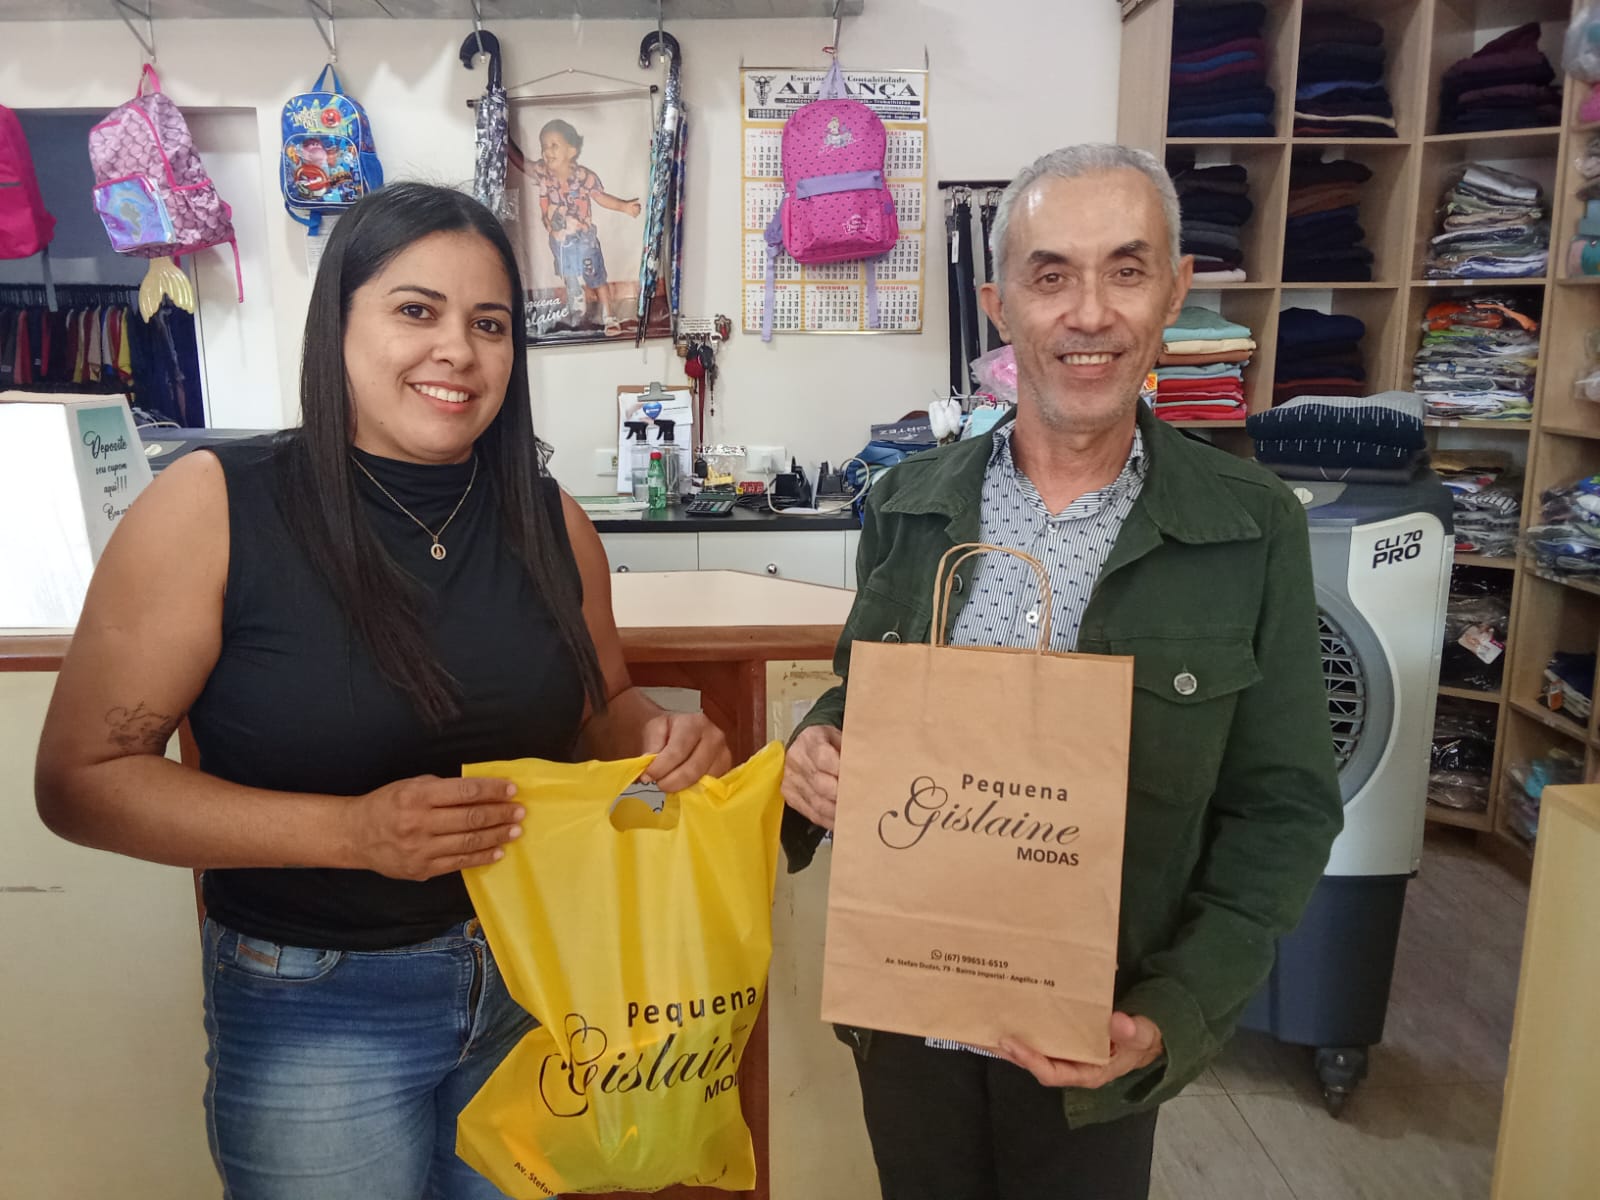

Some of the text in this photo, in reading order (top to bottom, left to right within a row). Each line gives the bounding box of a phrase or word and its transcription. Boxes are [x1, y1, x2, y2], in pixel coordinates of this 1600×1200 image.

[790, 74, 824, 82] Escritór
[847, 74, 907, 83] Contabilidade
[83, 430, 128, 460] Deposite
[1374, 529, 1423, 551] CLI 70
[1372, 543, 1421, 569] PRO
[962, 774, 1068, 802] Pequena
[878, 776, 1080, 850] Gislaine
[1016, 847, 1080, 866] MODAS
[944, 953, 960, 963] (67)
[627, 986, 757, 1028] Pequena
[539, 1013, 737, 1117] Gislain
[513, 1161, 528, 1177] Av.
